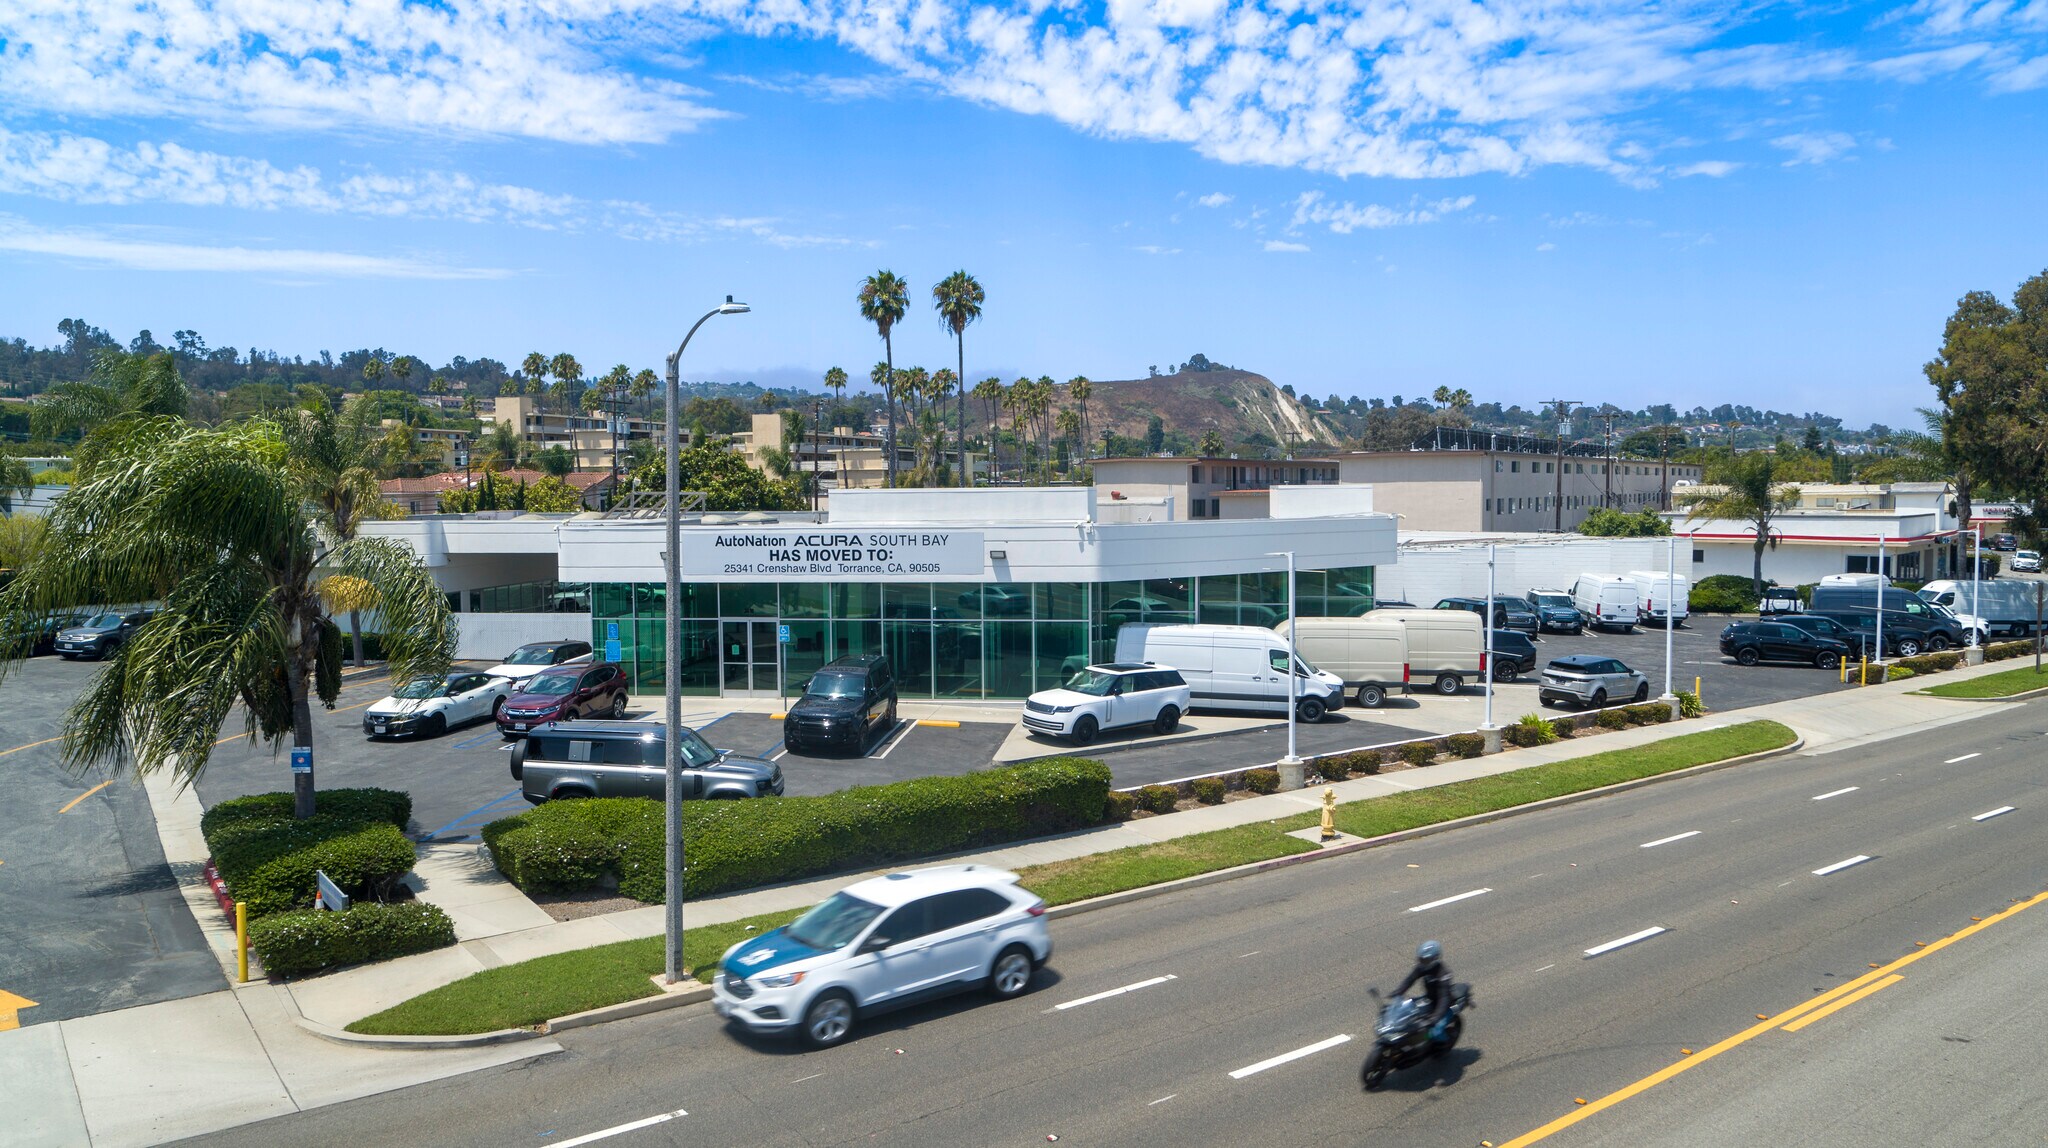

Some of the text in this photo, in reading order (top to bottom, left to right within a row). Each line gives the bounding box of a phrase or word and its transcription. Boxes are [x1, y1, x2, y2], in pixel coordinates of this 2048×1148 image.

[715, 535, 949, 547] AutoNation ACURA SOUTH BAY
[769, 549, 893, 562] HAS MOVED TO:
[724, 563, 941, 575] 25341 Crenshaw Blvd Torrance, CA, 90505
